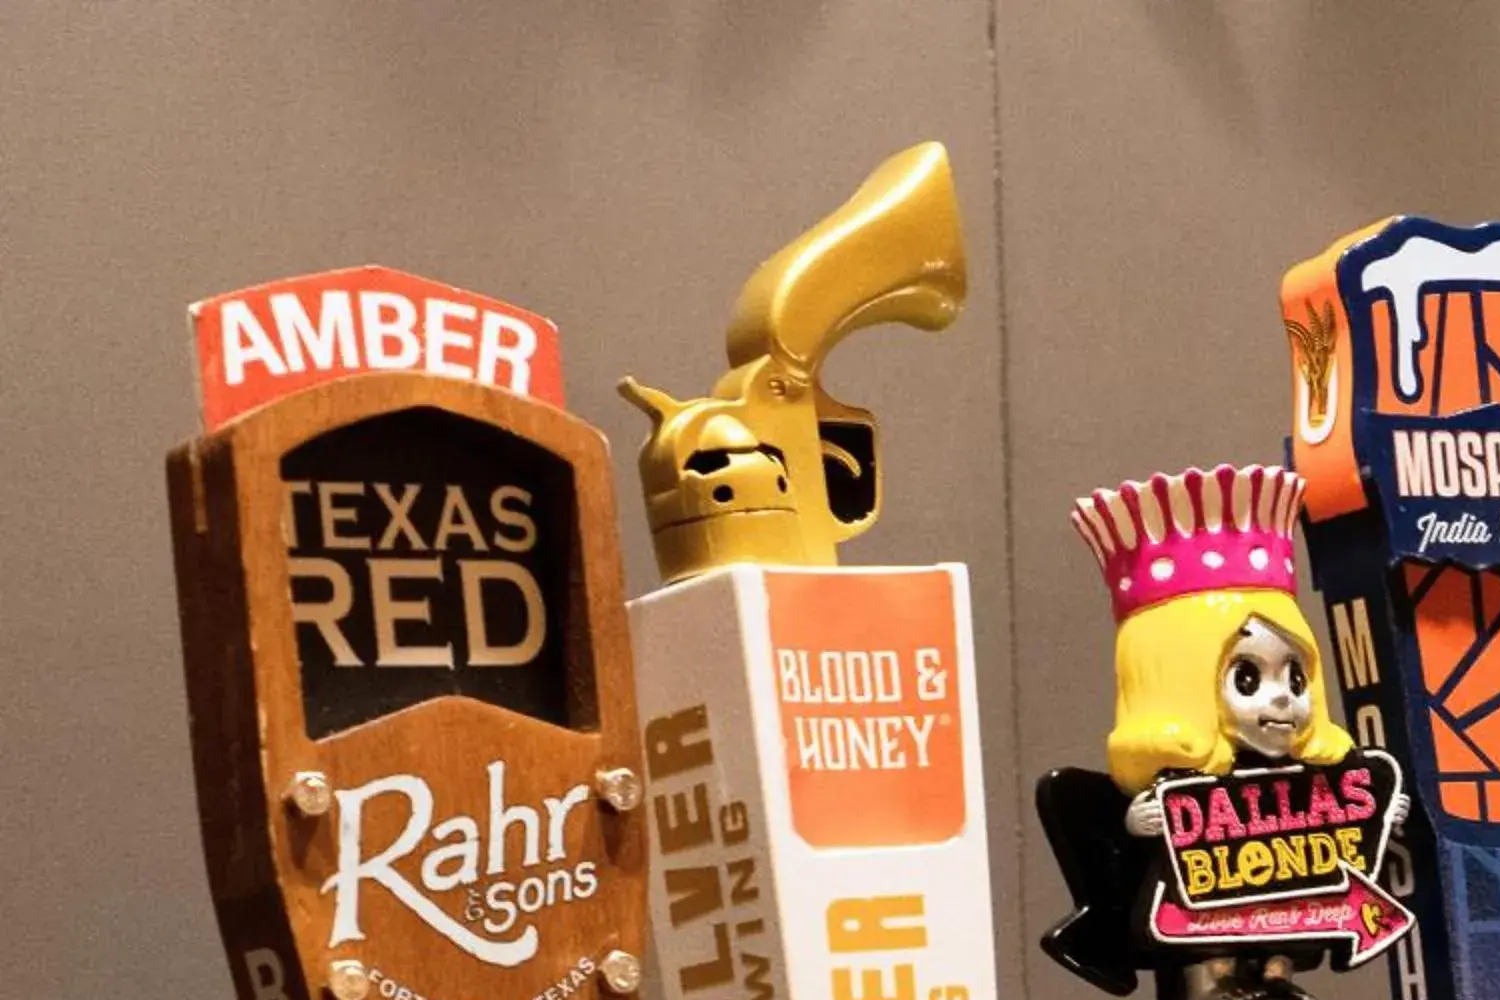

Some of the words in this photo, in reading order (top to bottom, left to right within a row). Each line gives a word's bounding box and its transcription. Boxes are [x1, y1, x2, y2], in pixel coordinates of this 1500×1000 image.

[220, 290, 538, 398] AMBER
[282, 480, 538, 552] TEXAS
[1417, 511, 1492, 552] India
[287, 556, 547, 671] RED
[777, 649, 902, 703] BLOOD
[915, 647, 948, 701] &
[794, 715, 936, 770] HONEY
[1165, 768, 1377, 848] DALLAS
[321, 760, 590, 966] Rahr
[1181, 827, 1367, 896] BLONDE
[1305, 902, 1355, 929] Deep
